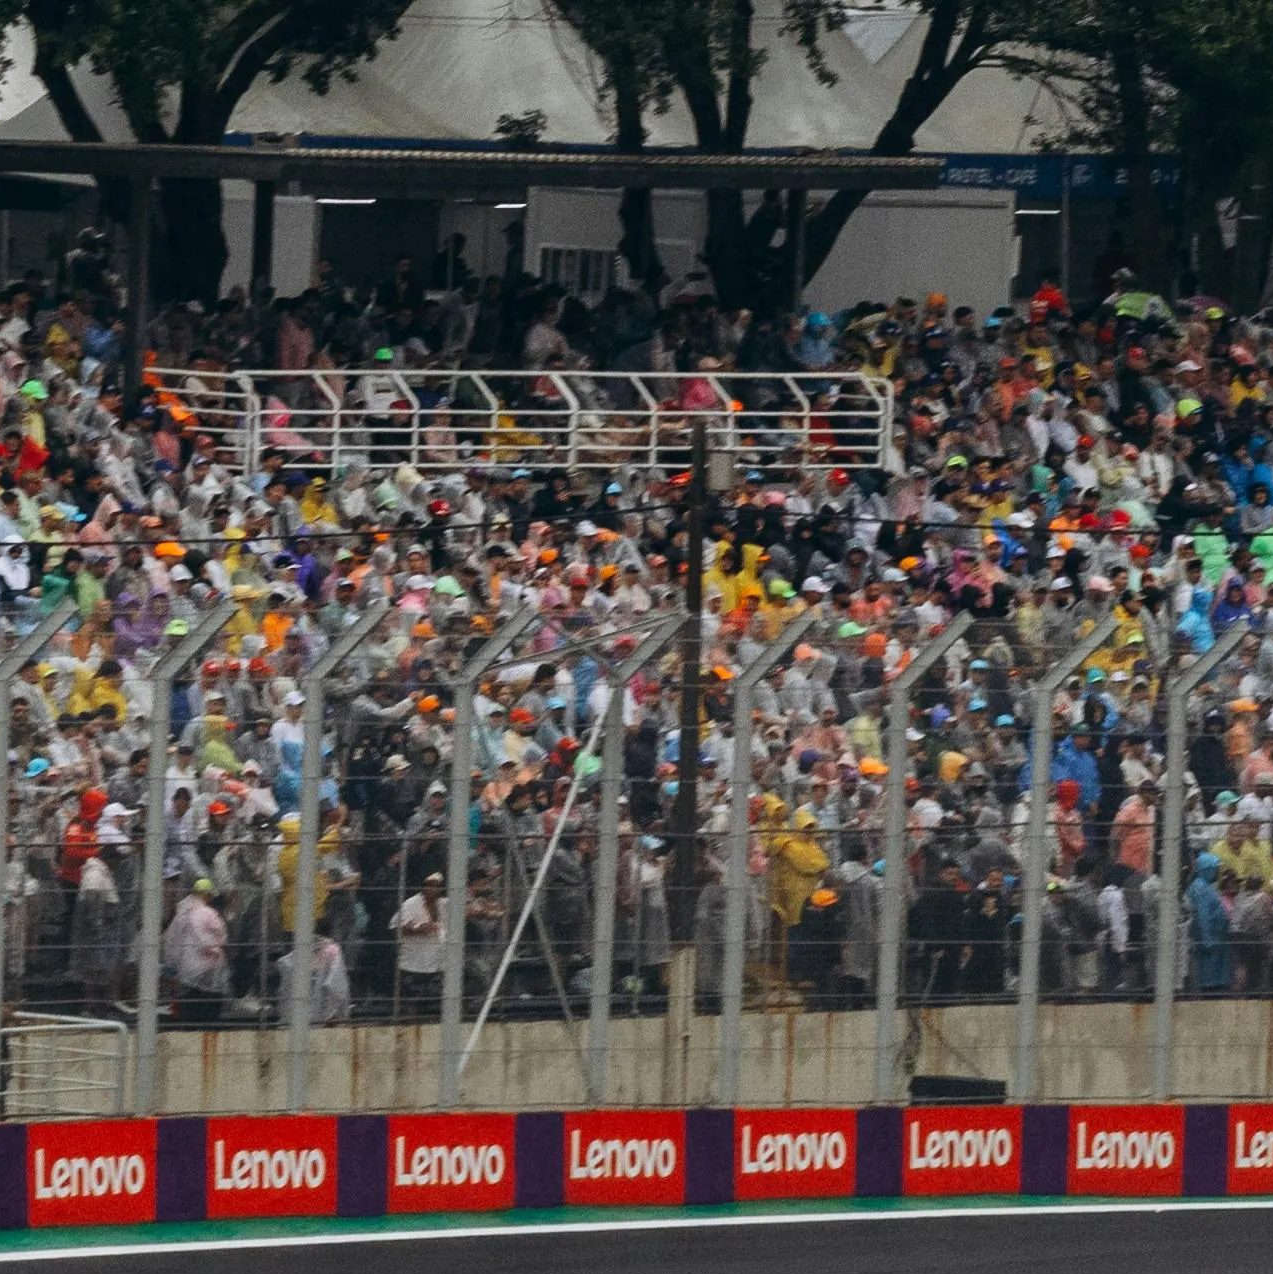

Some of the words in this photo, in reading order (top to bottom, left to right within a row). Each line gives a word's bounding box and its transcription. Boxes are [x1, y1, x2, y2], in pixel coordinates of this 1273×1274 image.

[214, 1139, 327, 1191] Lenovo
[394, 1135, 506, 1187] Lenovo
[569, 1129, 677, 1180] Lenovo
[741, 1125, 847, 1174] Lenovo
[909, 1121, 1013, 1170] Lenovo
[1075, 1121, 1175, 1170] Lenovo
[34, 1148, 146, 1200] Lenovo
